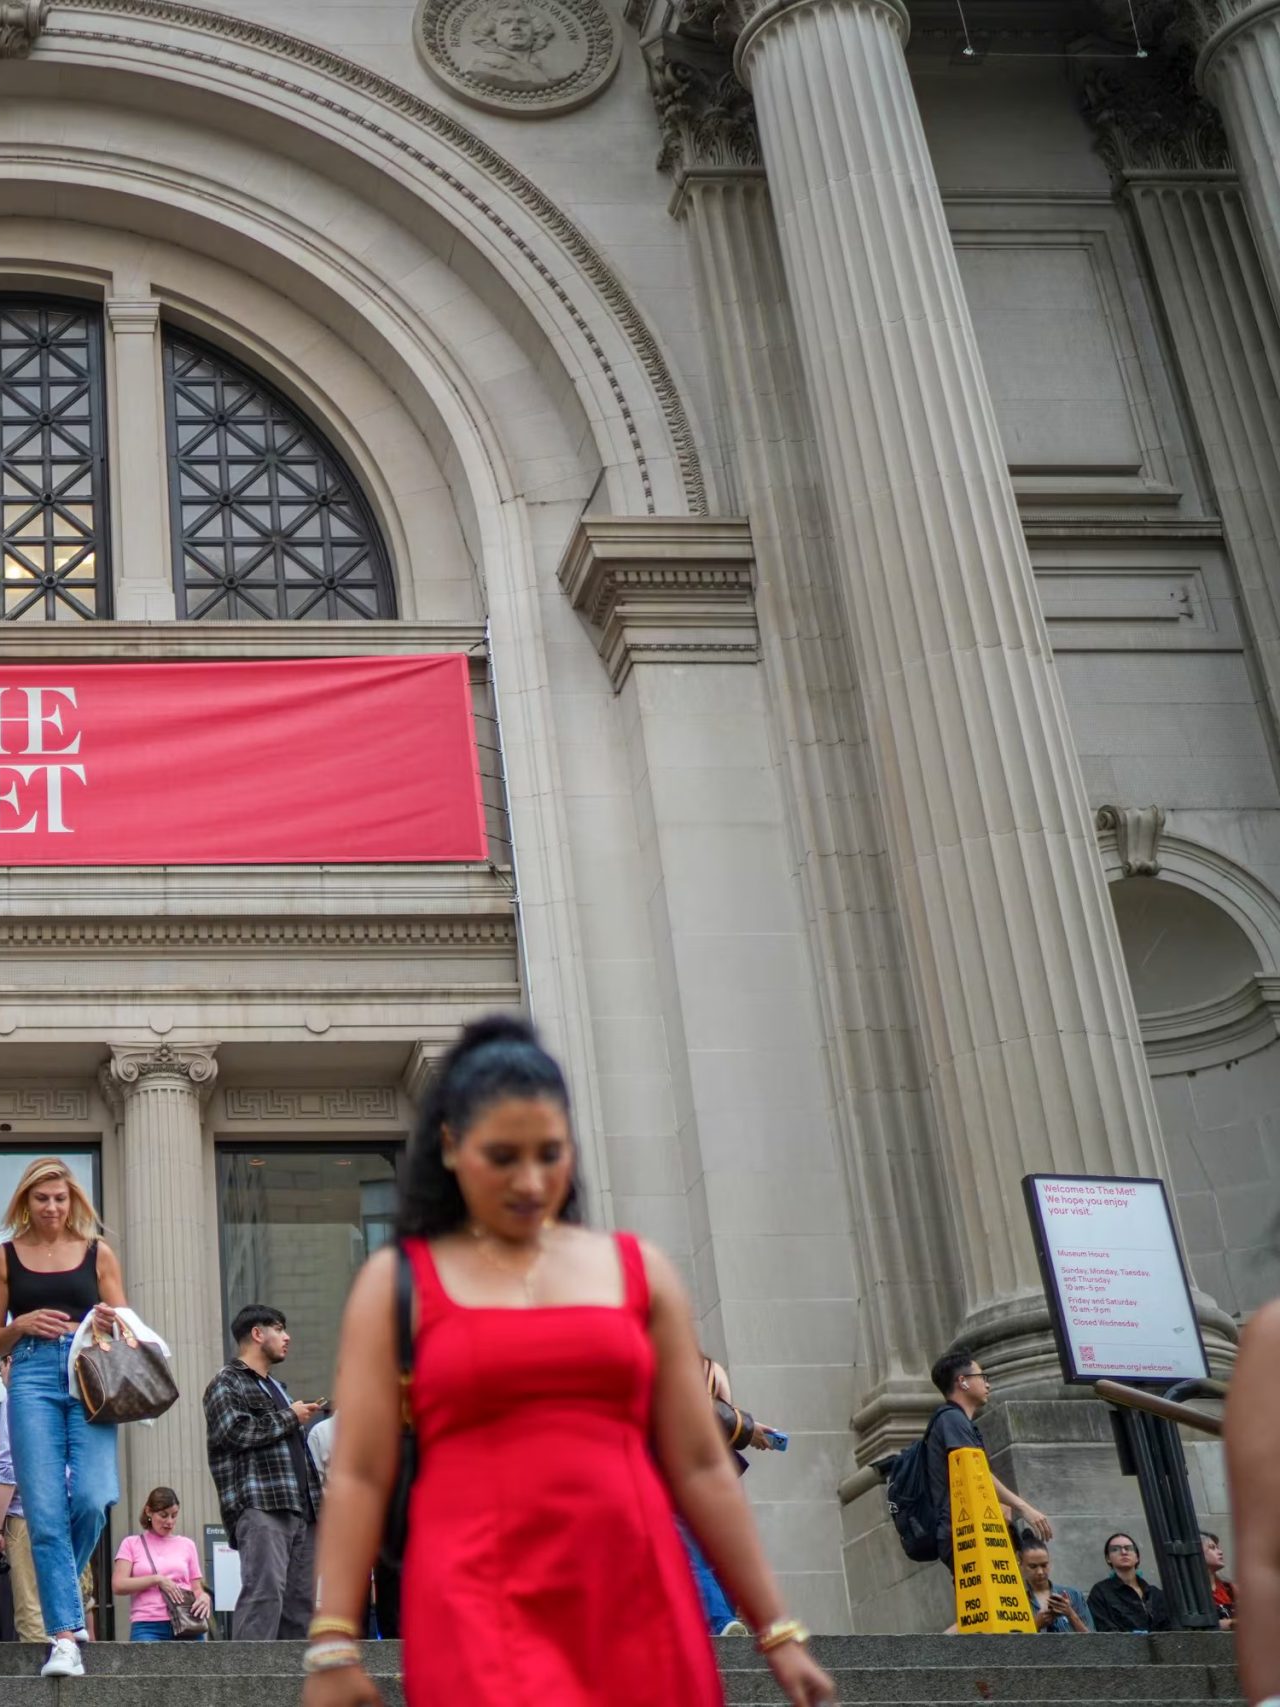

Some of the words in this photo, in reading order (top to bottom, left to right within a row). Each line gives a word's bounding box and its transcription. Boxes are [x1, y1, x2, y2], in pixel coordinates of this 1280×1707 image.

[1043, 1184, 1084, 1194] Welcome
[1086, 1186, 1095, 1194] to
[1096, 1186, 1114, 1195] The
[1116, 1187, 1136, 1196] Met!
[1046, 1195, 1060, 1204] We
[1061, 1196, 1084, 1206] hope
[1085, 1199, 1102, 1207] you
[1104, 1198, 1128, 1208] enjoy
[1048, 1207, 1069, 1216] your
[1071, 1207, 1092, 1216] visit.
[1061, 1267, 1089, 1275] Sunday,
[1090, 1268, 1118, 1276] Monday,
[1077, 1276, 1111, 1285] Thursday
[1068, 1297, 1090, 1305] Friday
[1106, 1298, 1137, 1306] Saturday
[1098, 1319, 1139, 1328] Wednesday
[961, 1561, 976, 1574] WET
[992, 1560, 1009, 1570] WET
[960, 1575, 982, 1589] FLOOR
[991, 1573, 1018, 1584] FLOOR
[965, 1598, 981, 1611] PISO
[999, 1596, 1019, 1607] PISO
[960, 1611, 989, 1627] MOJADO
[996, 1610, 1030, 1622] MOJADO
